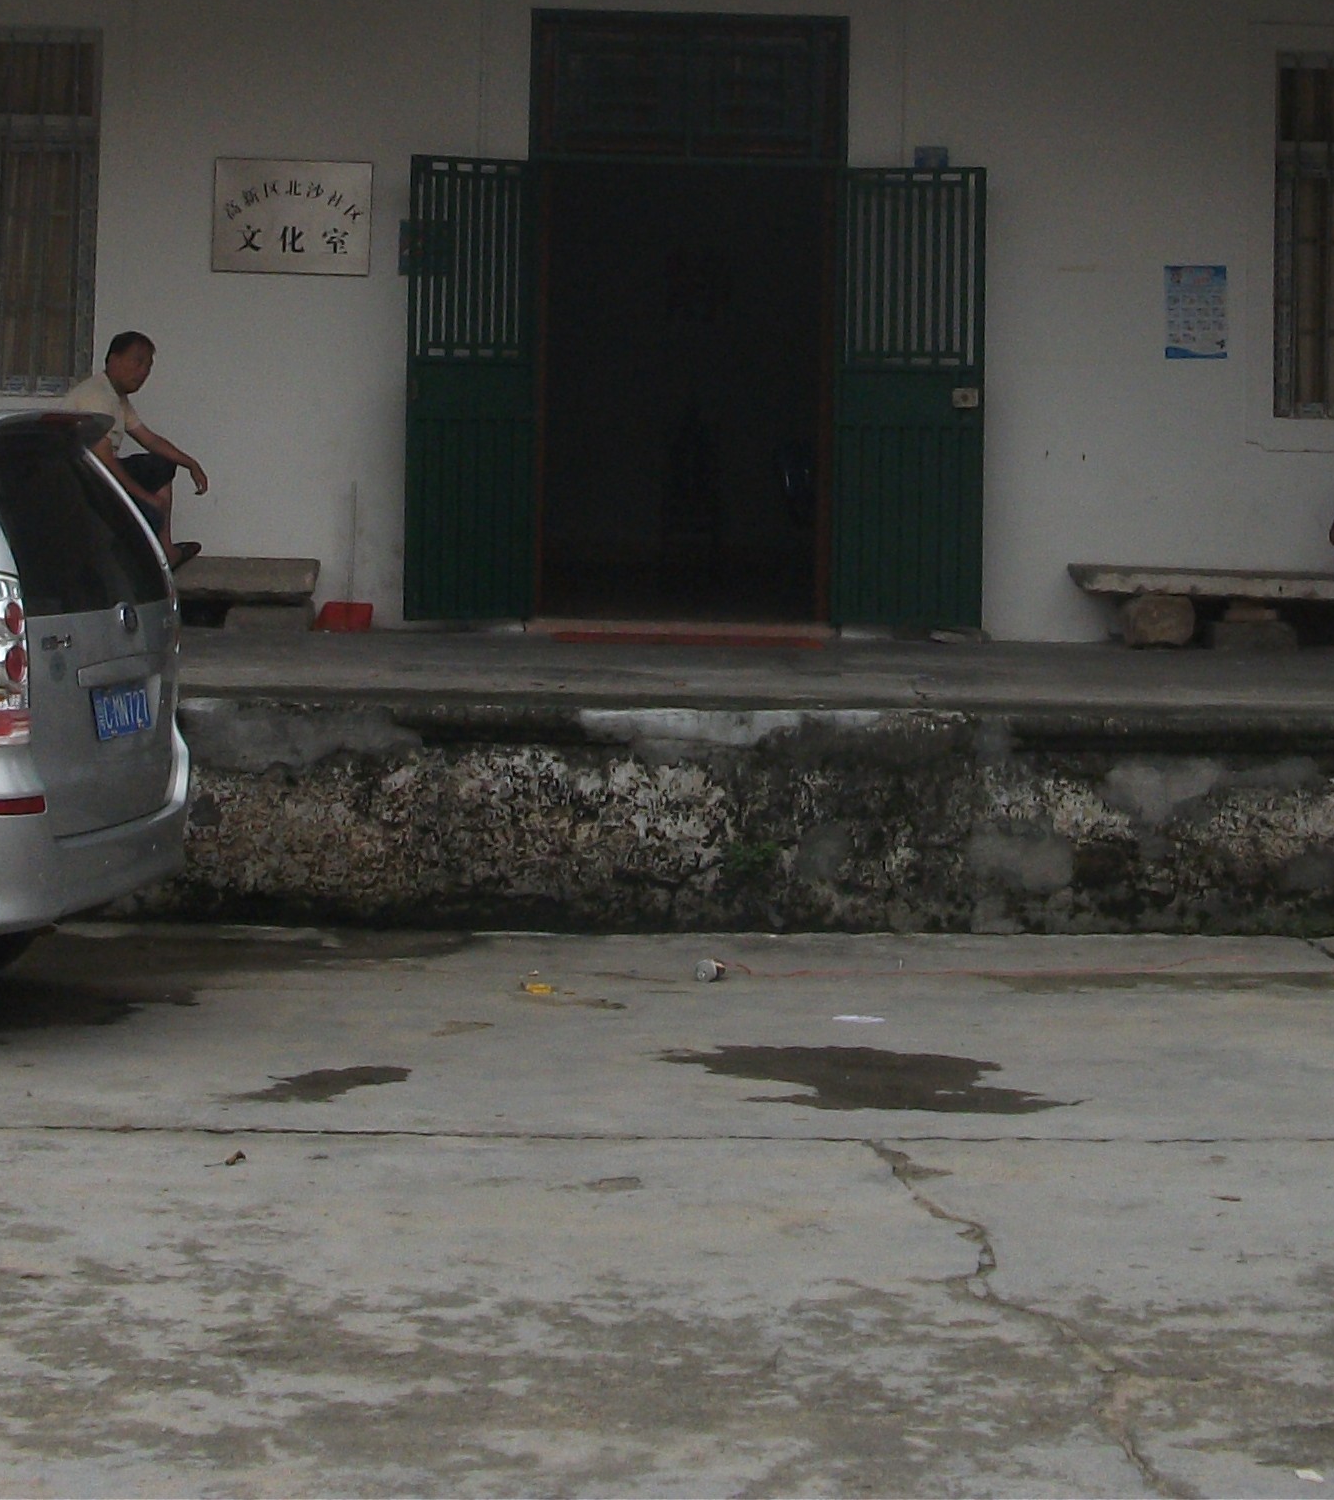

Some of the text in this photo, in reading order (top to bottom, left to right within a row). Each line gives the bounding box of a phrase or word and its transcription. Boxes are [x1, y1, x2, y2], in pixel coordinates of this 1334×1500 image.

[225, 179, 364, 223] 高新区北沙社区
[236, 224, 350, 255] 文化室
